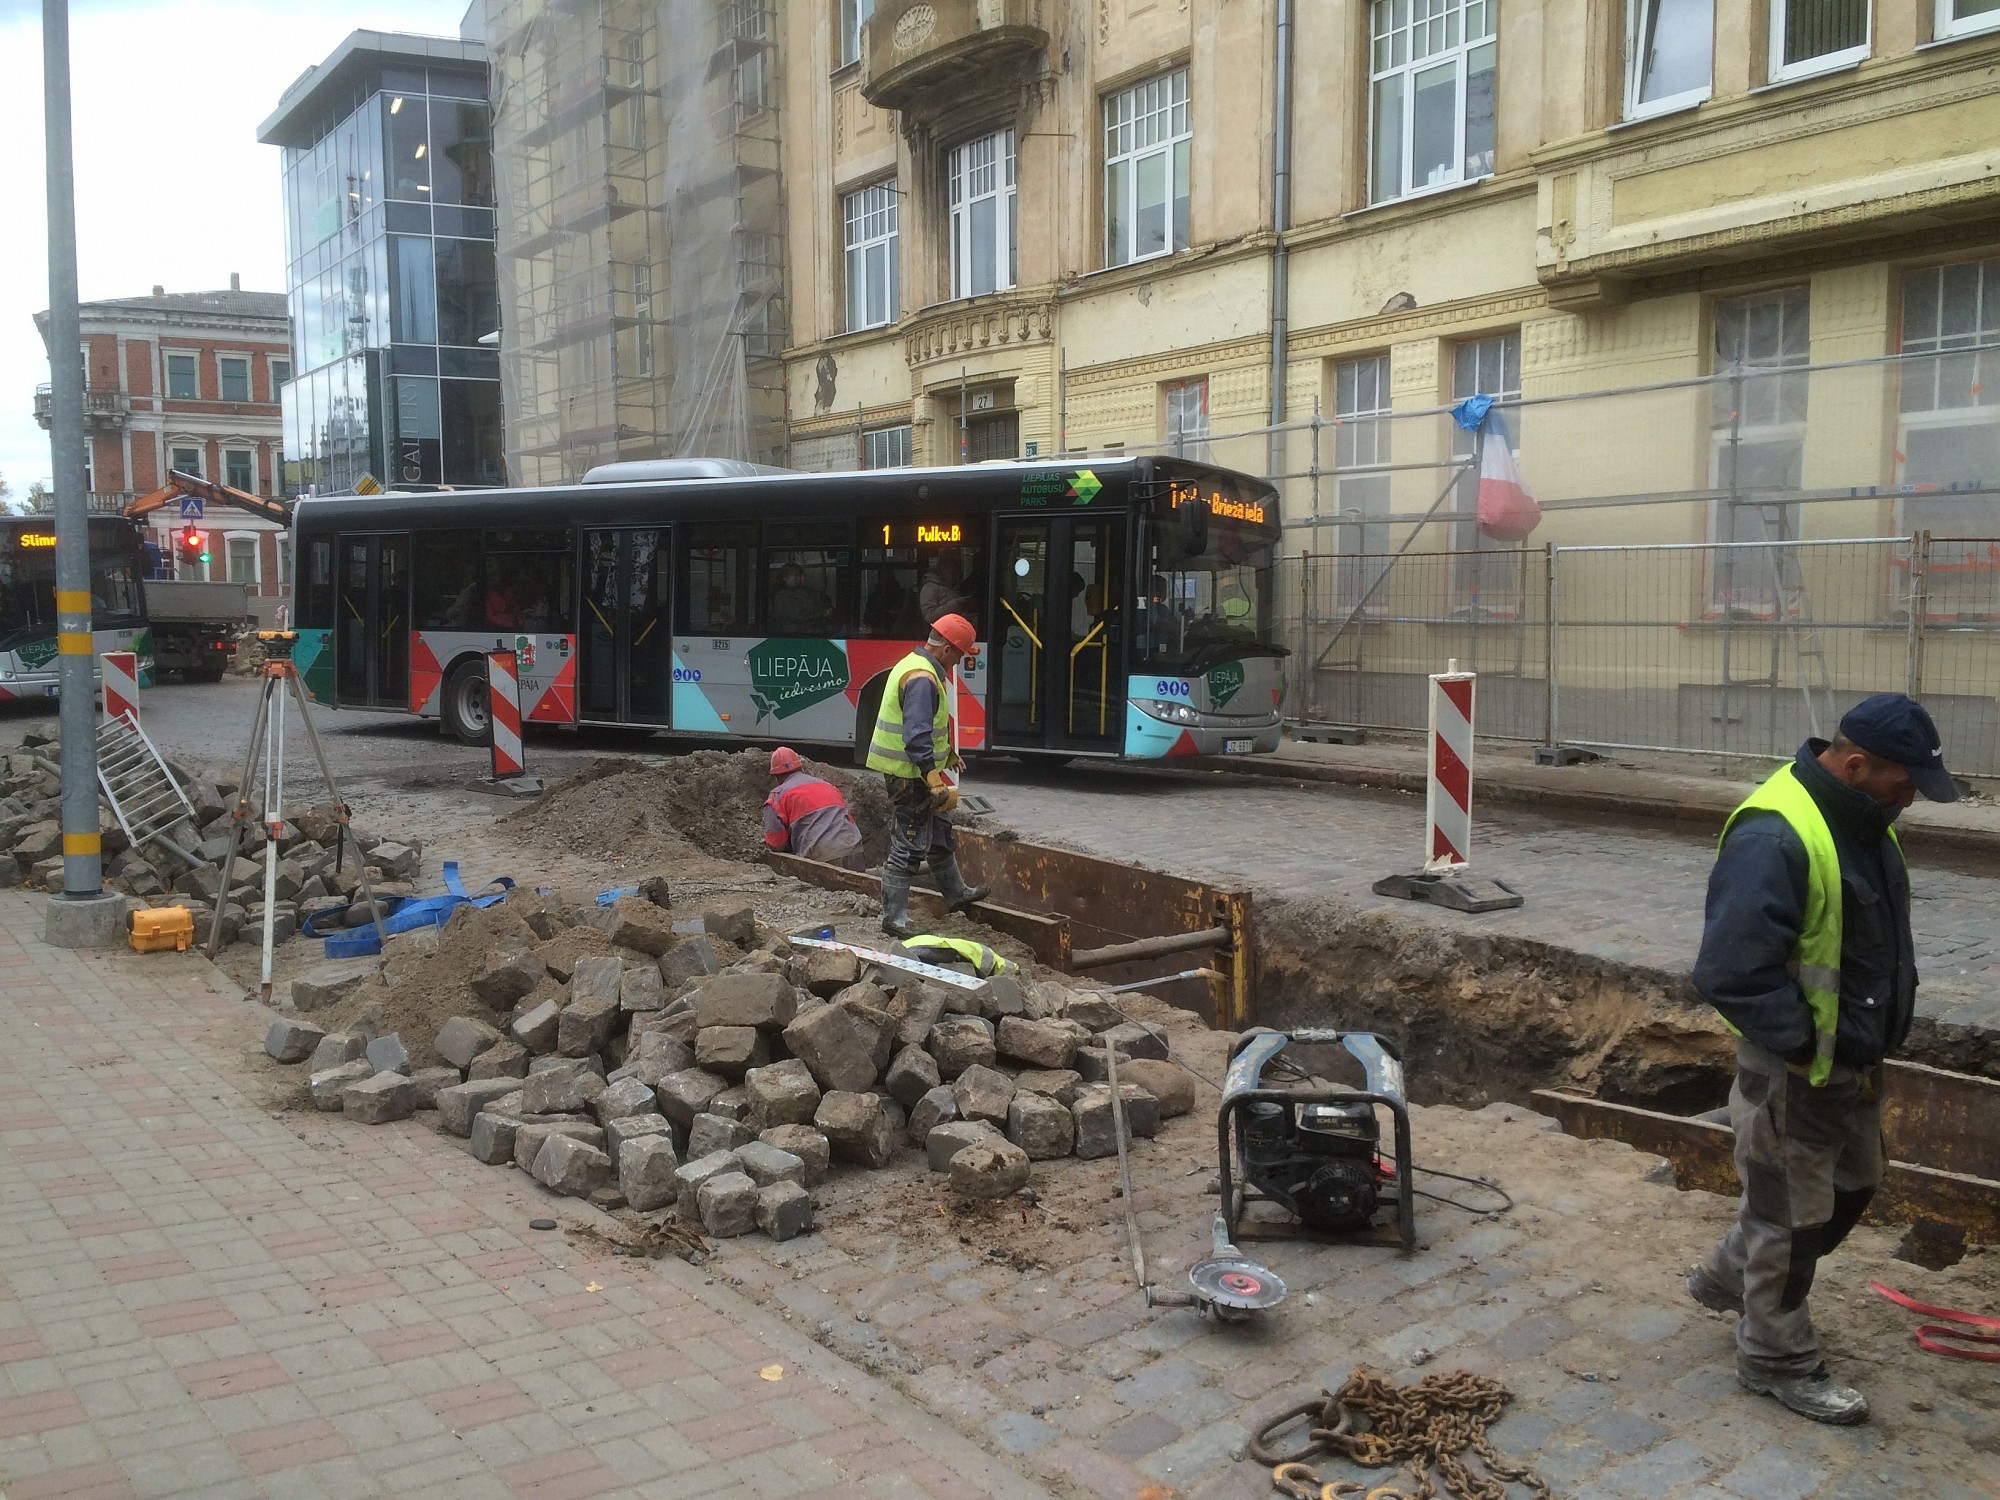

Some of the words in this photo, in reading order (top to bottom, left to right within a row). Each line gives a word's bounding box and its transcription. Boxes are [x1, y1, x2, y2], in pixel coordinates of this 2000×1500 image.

[978, 395, 988, 408] 27
[401, 382, 421, 482] GALLERY
[1020, 484, 1065, 495] AUTOBUSU
[1020, 497, 1047, 506] PARKS
[882, 524, 890, 546] 1
[20, 643, 58, 655] LIEPĀJA
[756, 654, 835, 678] LIEPĀJA
[1209, 670, 1239, 684] LIEPĀJA
[779, 677, 847, 701] iedvesmo
